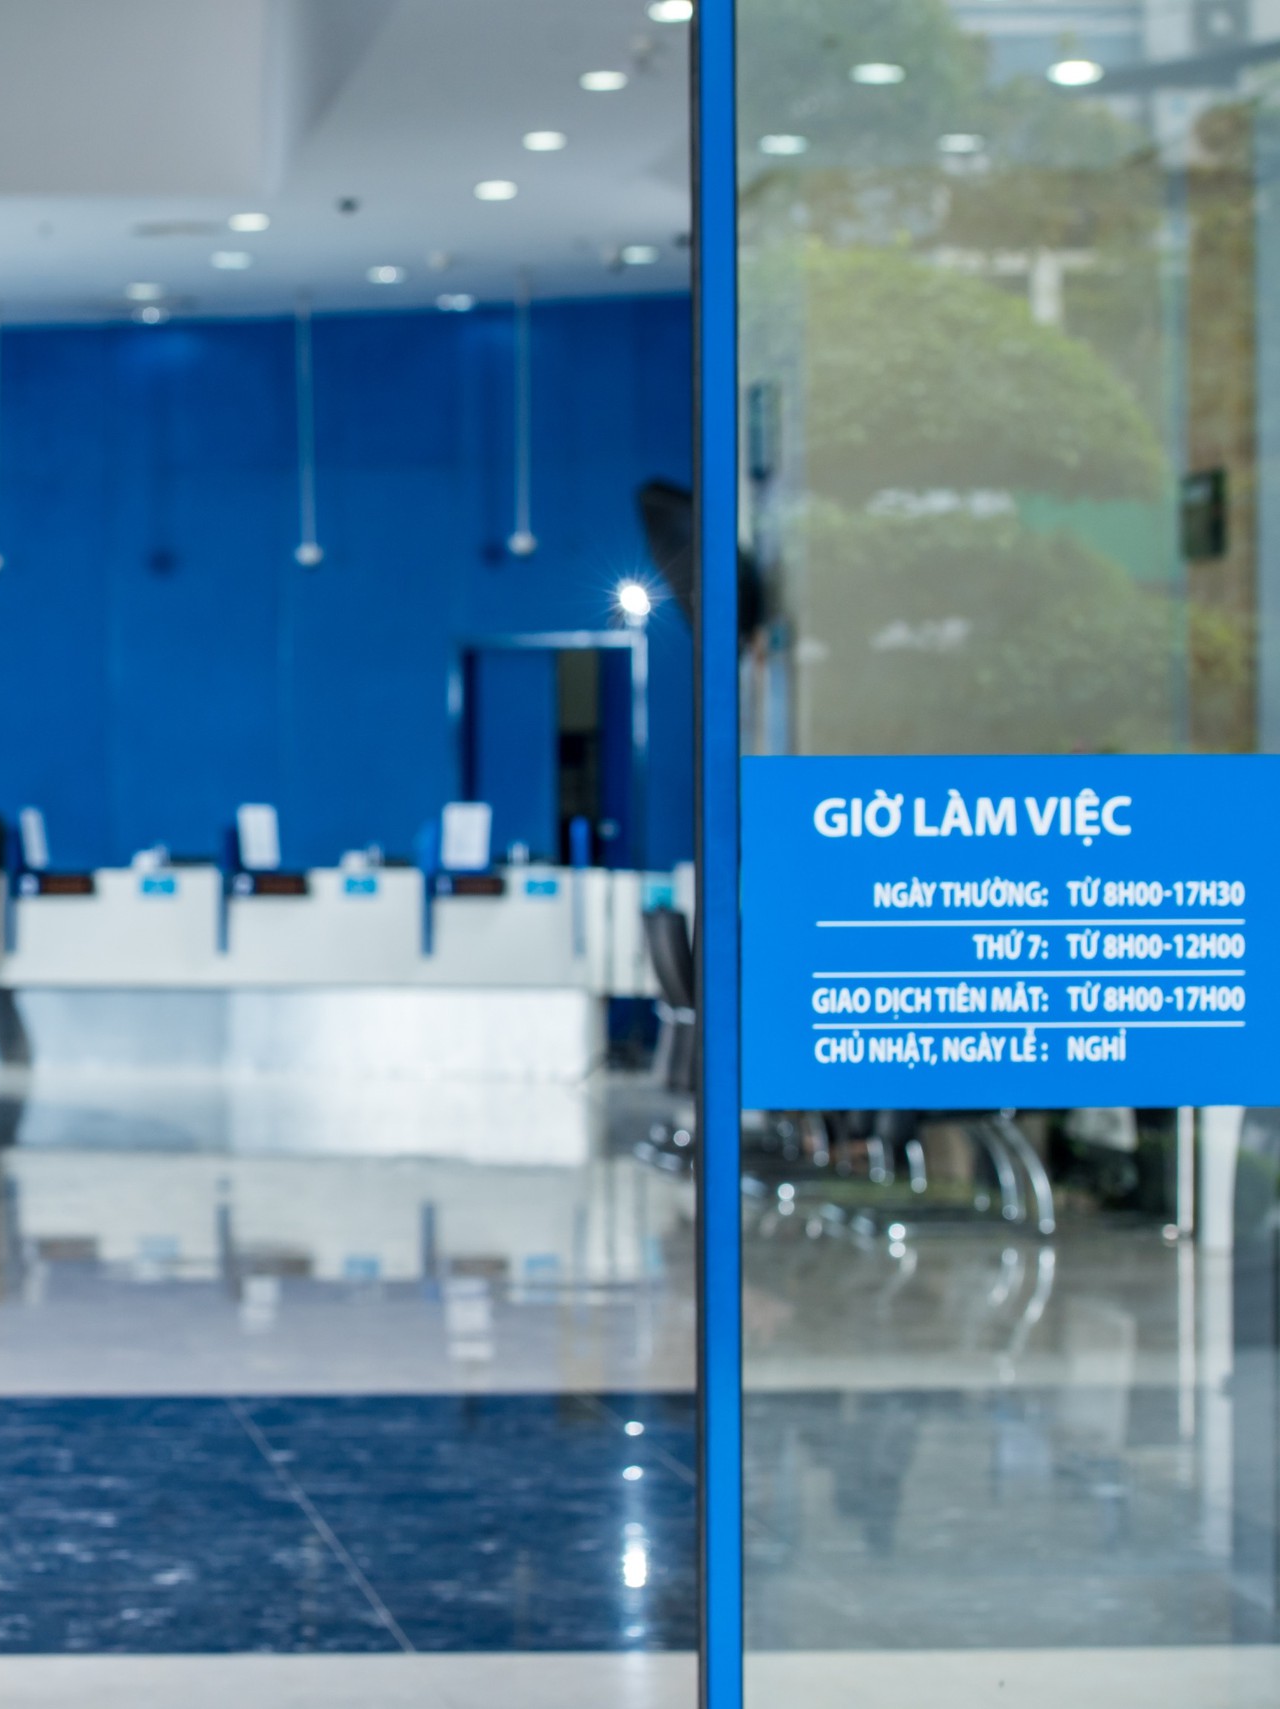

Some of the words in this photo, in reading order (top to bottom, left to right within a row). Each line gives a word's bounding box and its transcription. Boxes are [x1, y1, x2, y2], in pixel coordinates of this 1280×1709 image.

[813, 789, 904, 838] GIỜ
[914, 788, 1018, 837] LÀM
[1024, 788, 1132, 847] VIỆC
[873, 876, 937, 908] NGÀY
[939, 876, 1049, 908] THƯỜNG:
[1066, 876, 1101, 907] TỪ
[1103, 880, 1246, 907] 8H00-17H30
[972, 929, 1025, 960] THỨ
[1027, 934, 1049, 959] 7:
[1066, 928, 1101, 960] TỪ
[1103, 933, 1246, 960] 8H00-12H00
[811, 987, 872, 1014] GIAO
[875, 987, 932, 1021] DỊCH
[1066, 981, 1101, 1012] TỪ
[1103, 985, 1246, 1012] 8H00-17H00
[814, 1029, 865, 1064] CHỦ
[868, 1031, 938, 1069] NHẬT,
[942, 1031, 1007, 1063] NGÀY
[1067, 1028, 1127, 1062] NGHỈ
